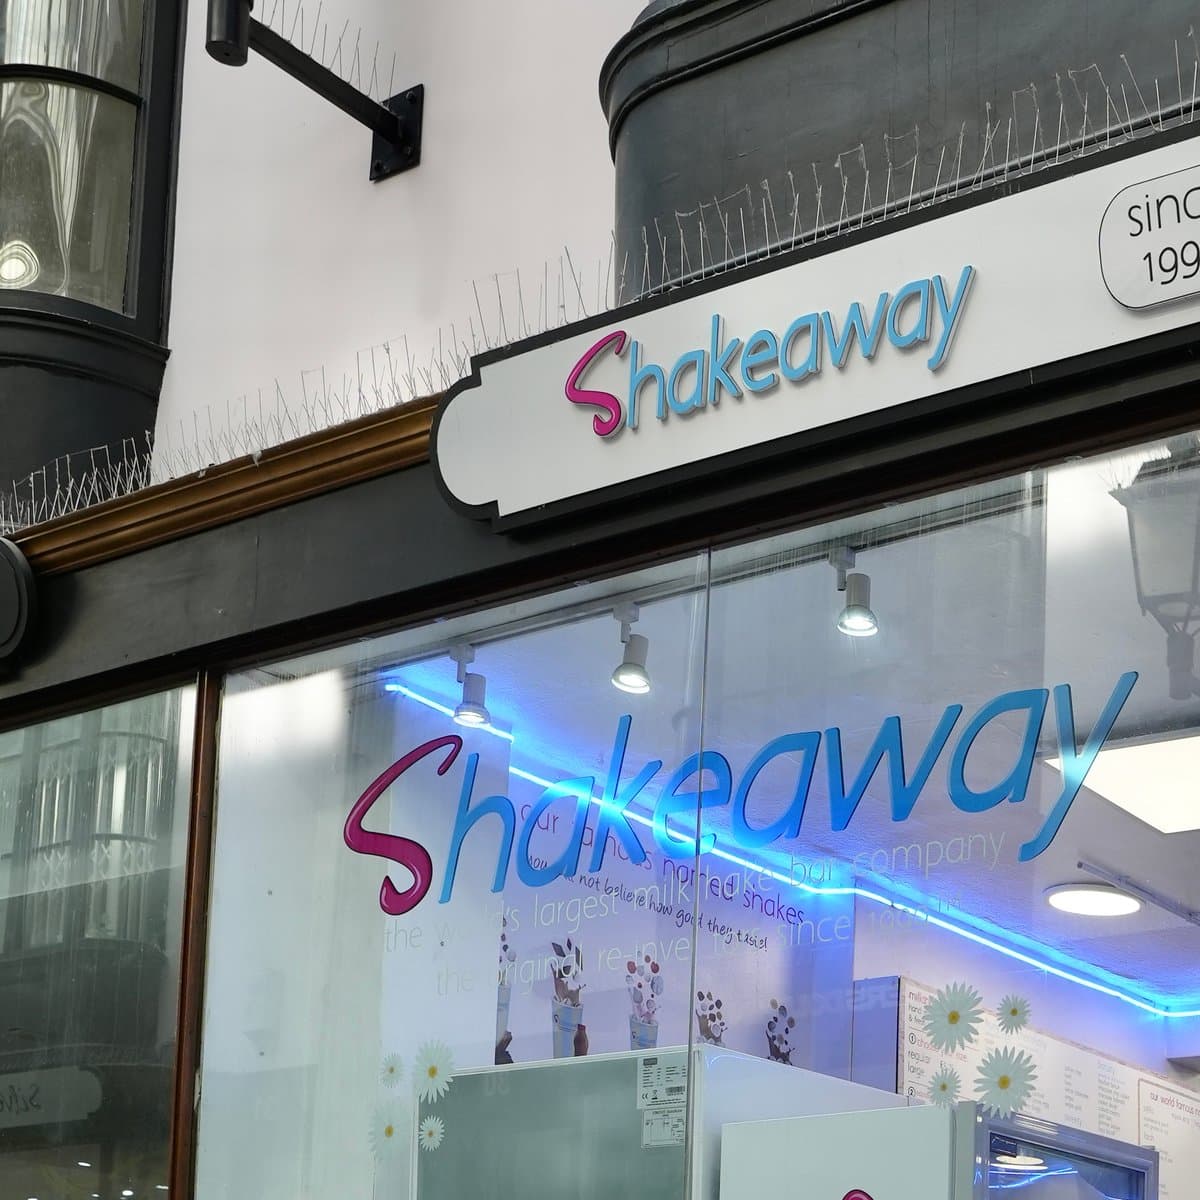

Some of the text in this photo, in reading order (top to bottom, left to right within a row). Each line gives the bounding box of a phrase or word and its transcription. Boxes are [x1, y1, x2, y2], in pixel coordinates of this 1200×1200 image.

[566, 265, 977, 438] Shakeaway
[343, 670, 1139, 916] Shakeaway
[533, 891, 619, 933] largest
[854, 830, 1006, 884] company
